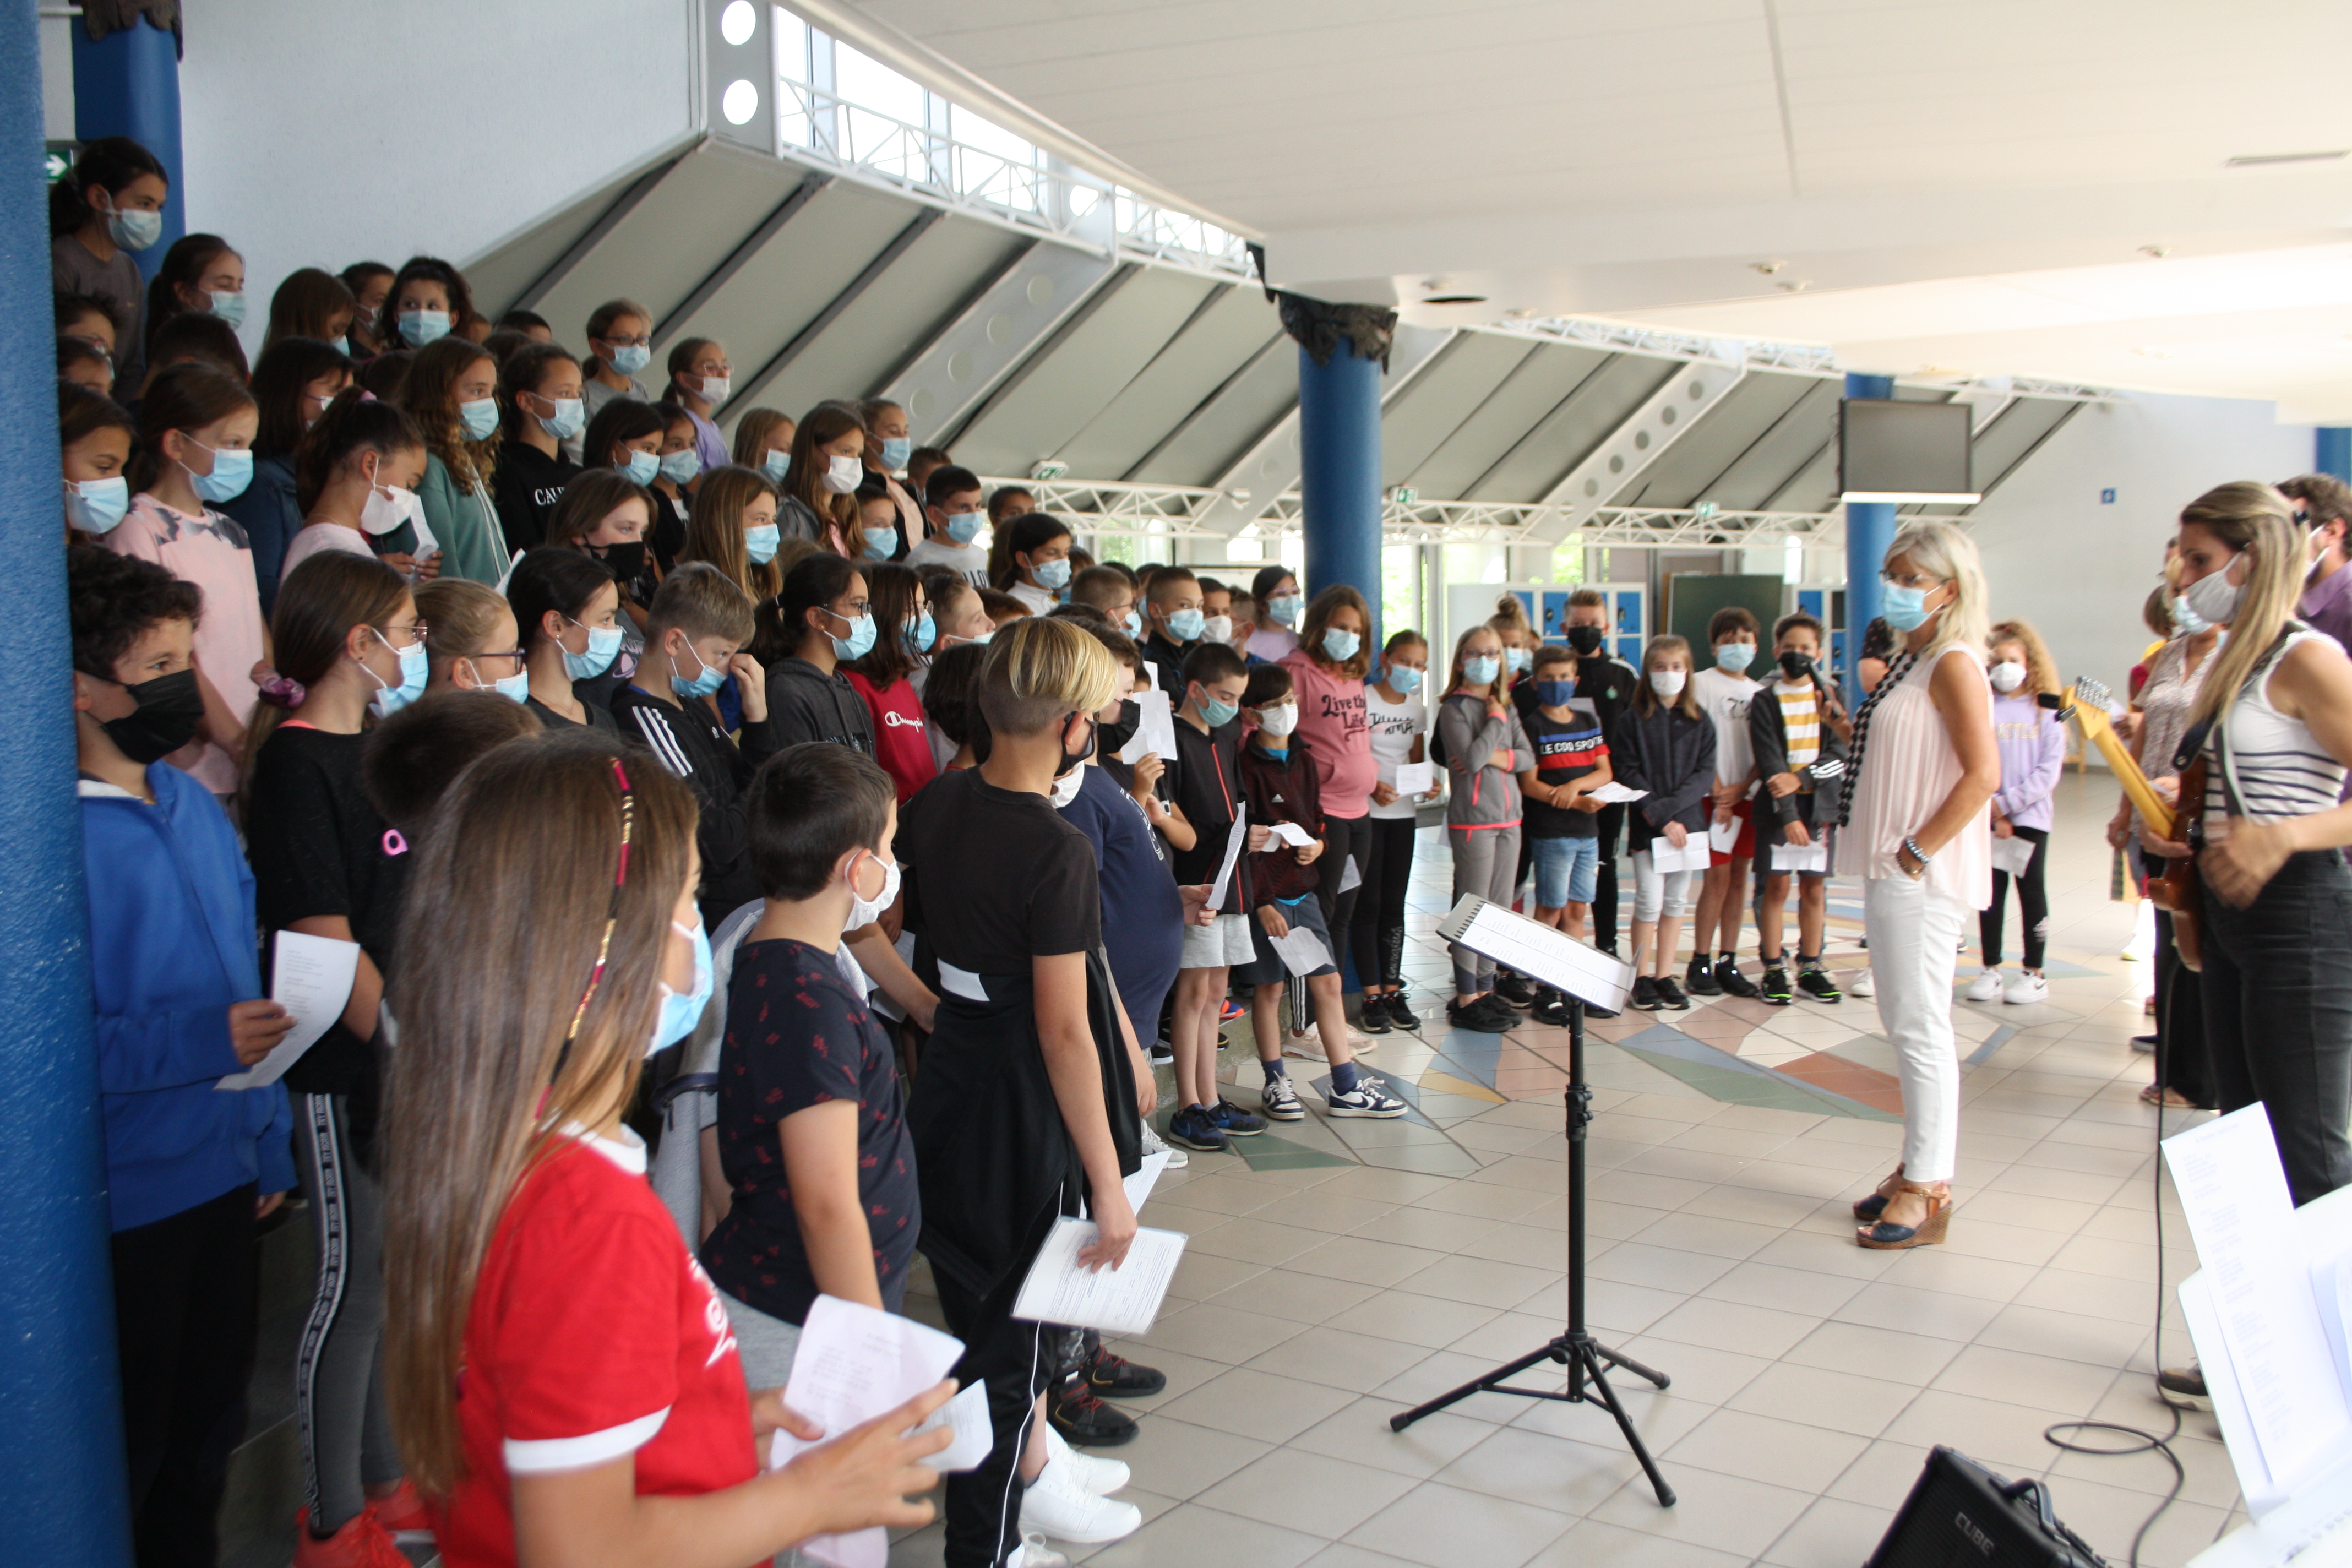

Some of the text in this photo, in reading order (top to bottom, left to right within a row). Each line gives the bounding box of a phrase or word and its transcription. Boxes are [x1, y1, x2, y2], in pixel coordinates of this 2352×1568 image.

[1321, 695, 1352, 717] Live
[1539, 743, 1554, 755] LE
[1954, 1511, 1995, 1556] CUBE
